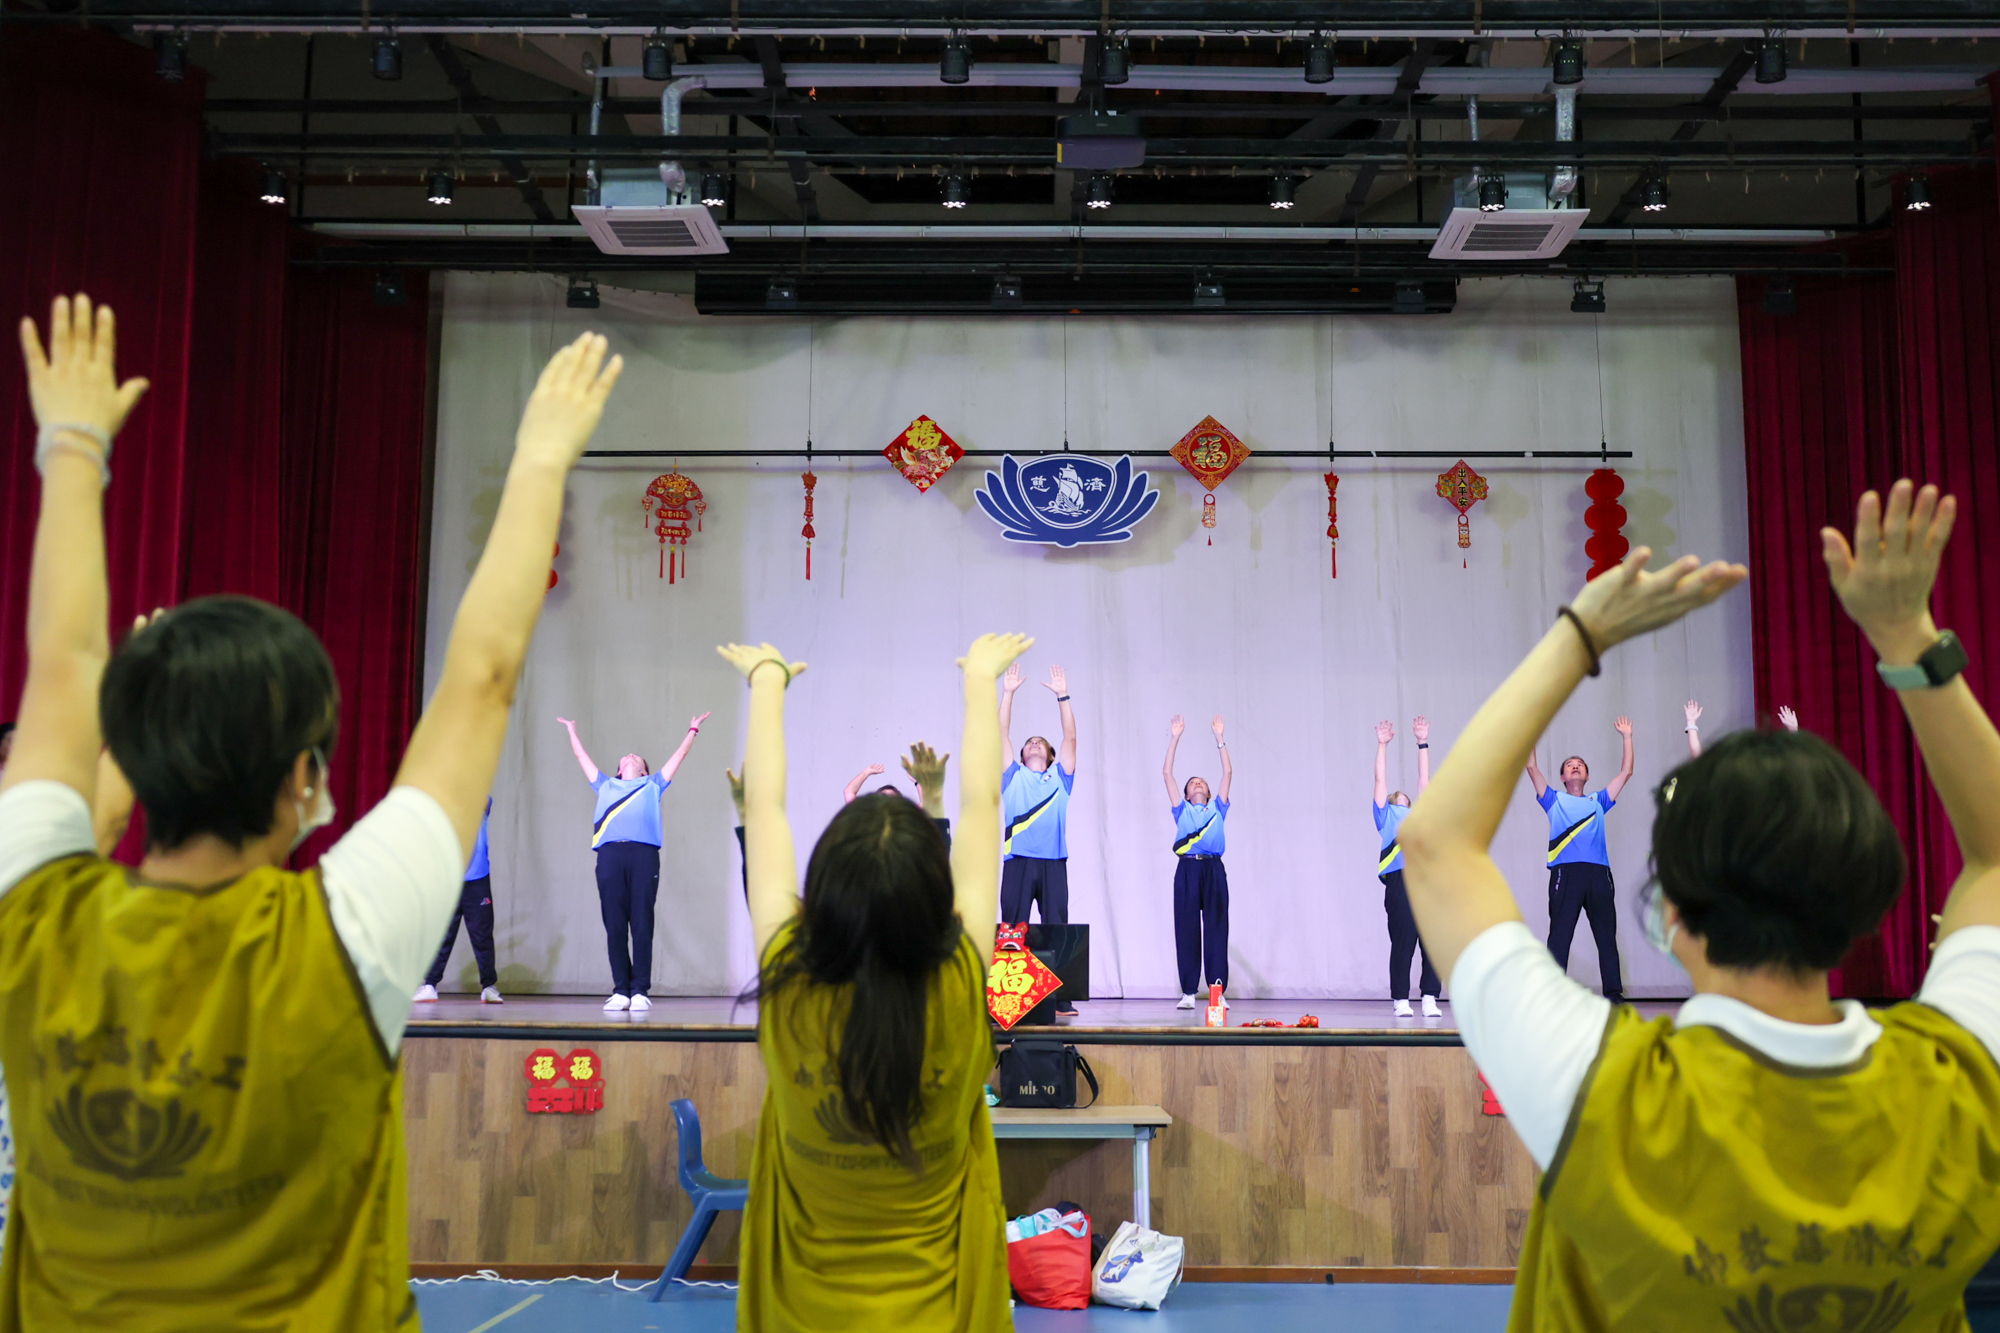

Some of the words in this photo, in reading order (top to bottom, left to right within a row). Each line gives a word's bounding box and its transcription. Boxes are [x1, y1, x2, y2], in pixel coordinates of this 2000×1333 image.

[906, 420, 942, 450] 福
[1192, 435, 1228, 468] 福
[1457, 468, 1468, 507] 出入平安
[986, 951, 1035, 995] 福
